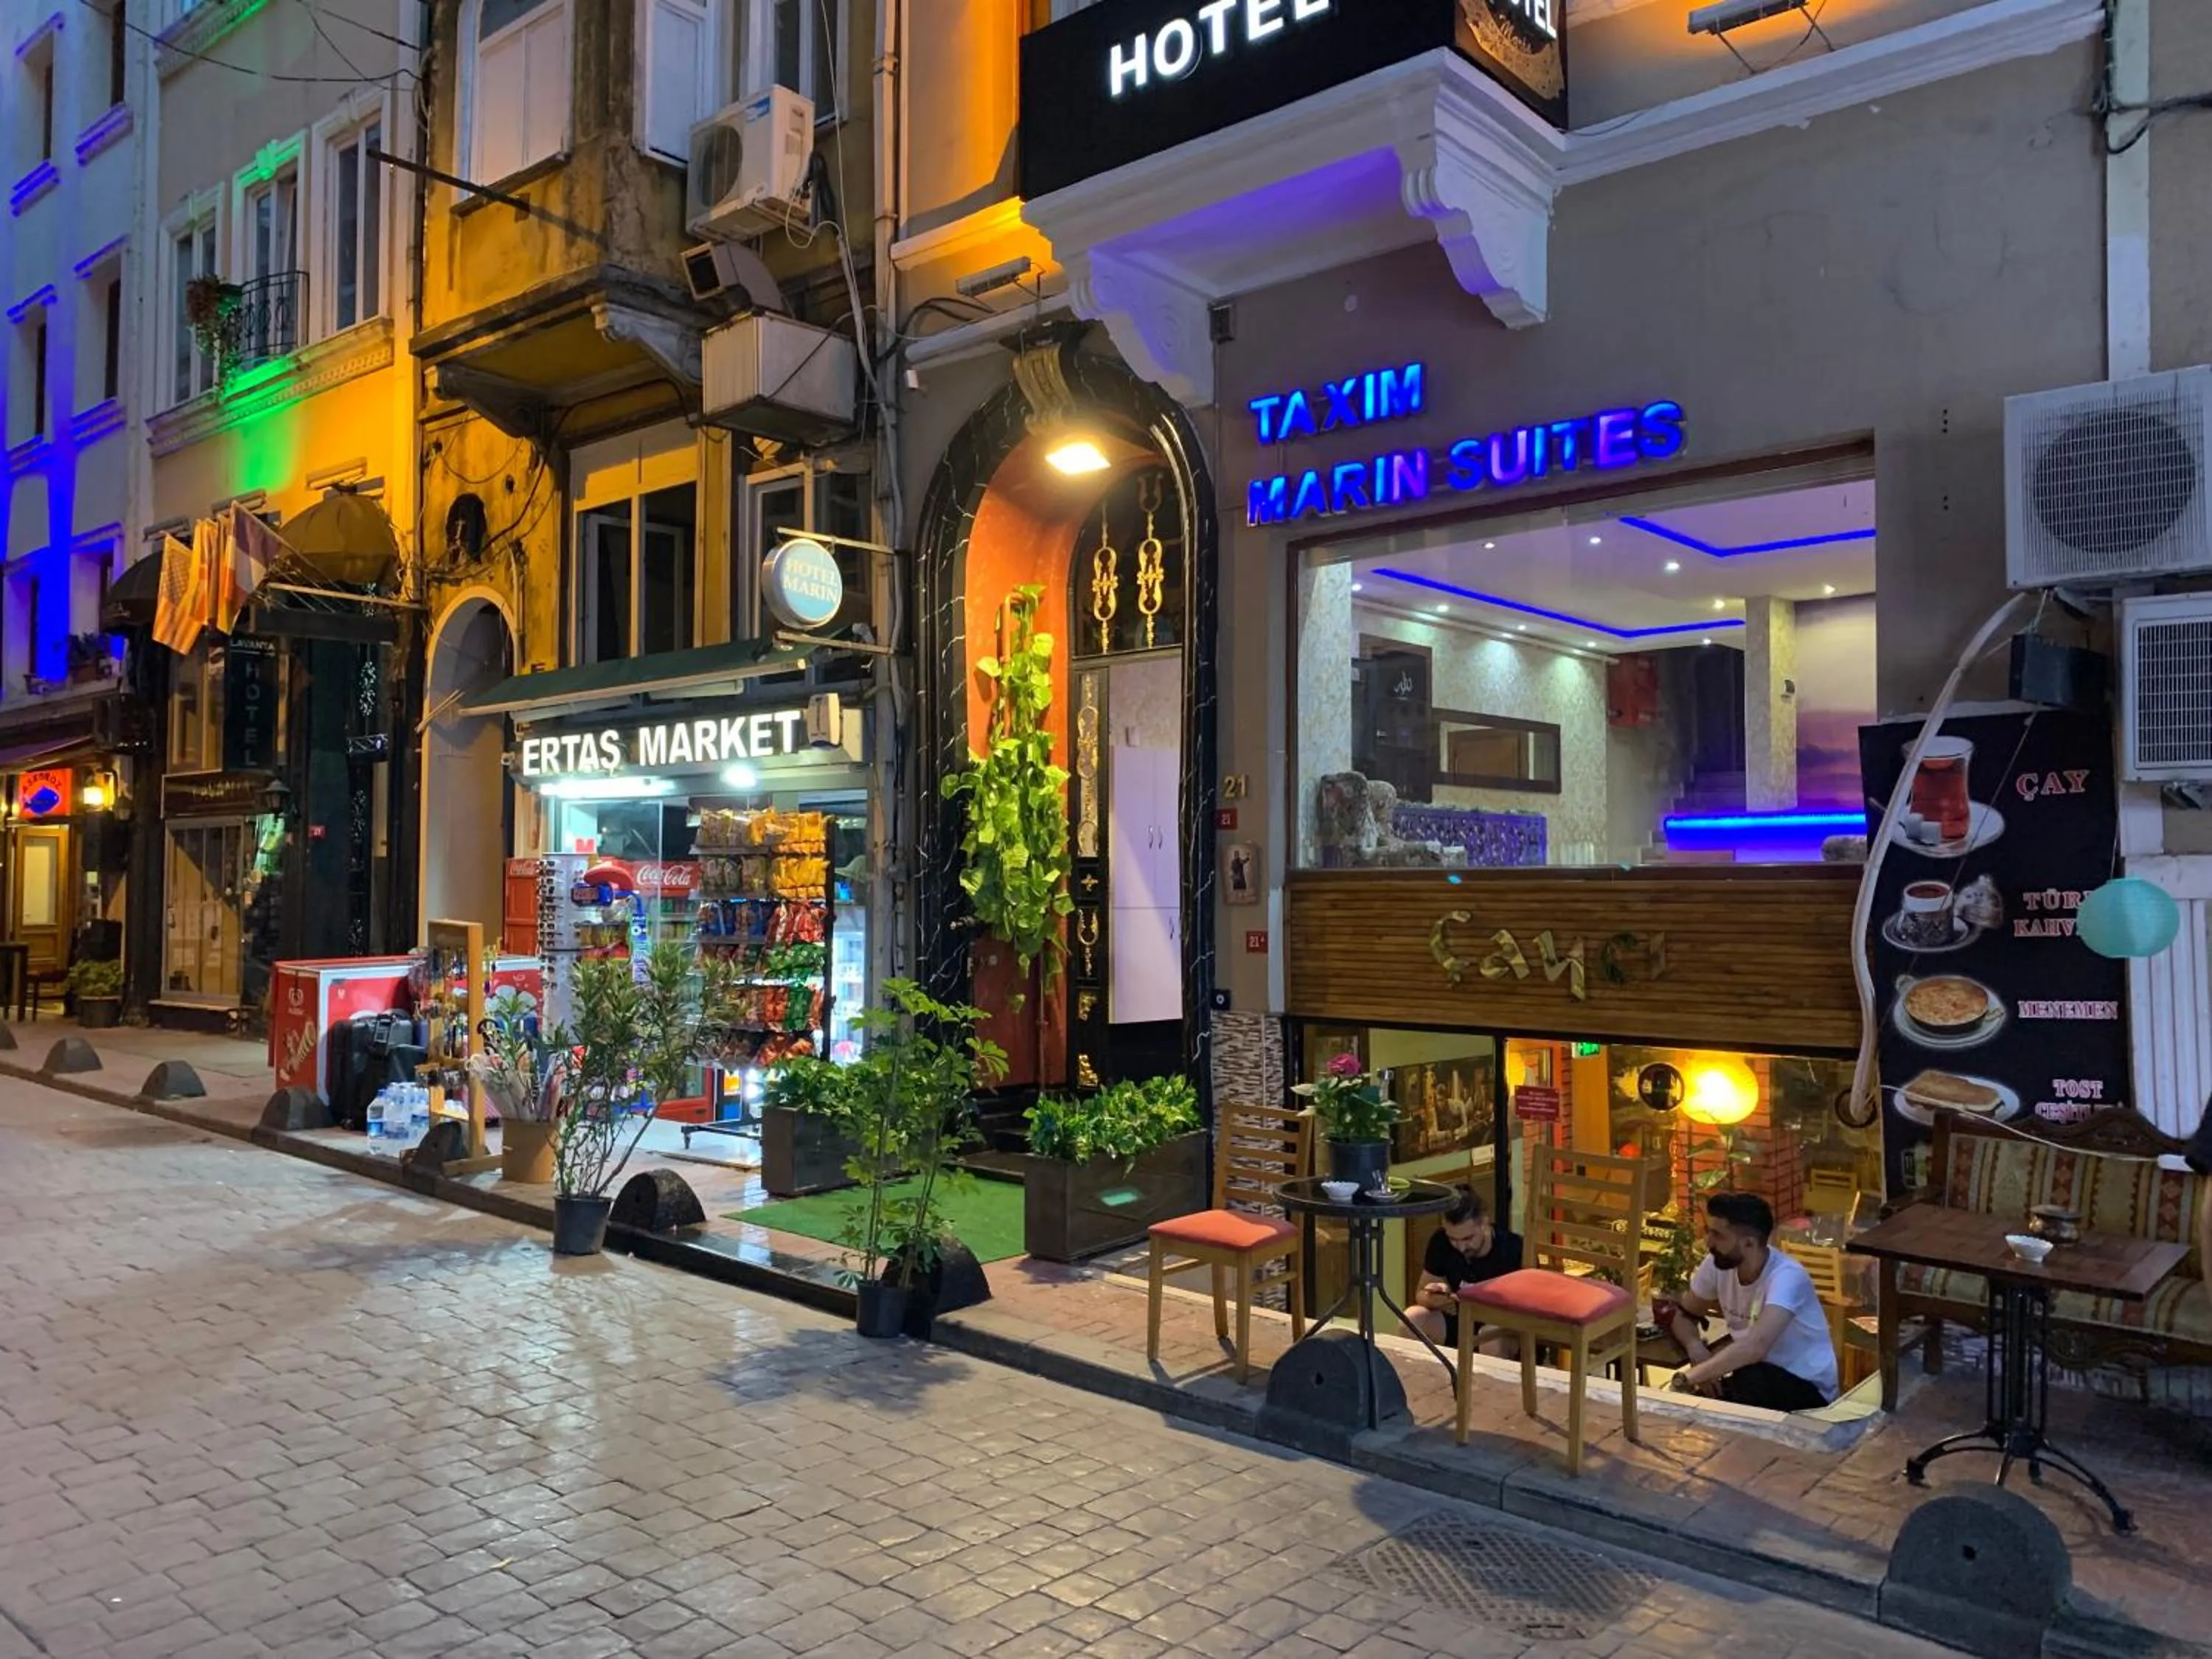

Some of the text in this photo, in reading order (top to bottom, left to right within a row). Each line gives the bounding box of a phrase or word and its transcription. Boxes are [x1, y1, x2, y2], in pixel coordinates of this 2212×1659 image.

[1109, 0, 1329, 97] HOTEL
[1249, 362, 1424, 443] TAXIM
[1247, 400, 1687, 526] MARIN SUITES
[785, 558, 838, 587] HOTEL
[783, 574, 839, 602] MARIN
[244, 661, 261, 766] HOTEL
[522, 710, 801, 776] ERTAŞ MARKET
[1224, 774, 1246, 799] 21
[2016, 770, 2090, 801] ÇAY
[2013, 918, 2077, 937] KAHV
[2018, 1000, 2118, 1020] MENEMEN
[2053, 1079, 2103, 1099] TOST
